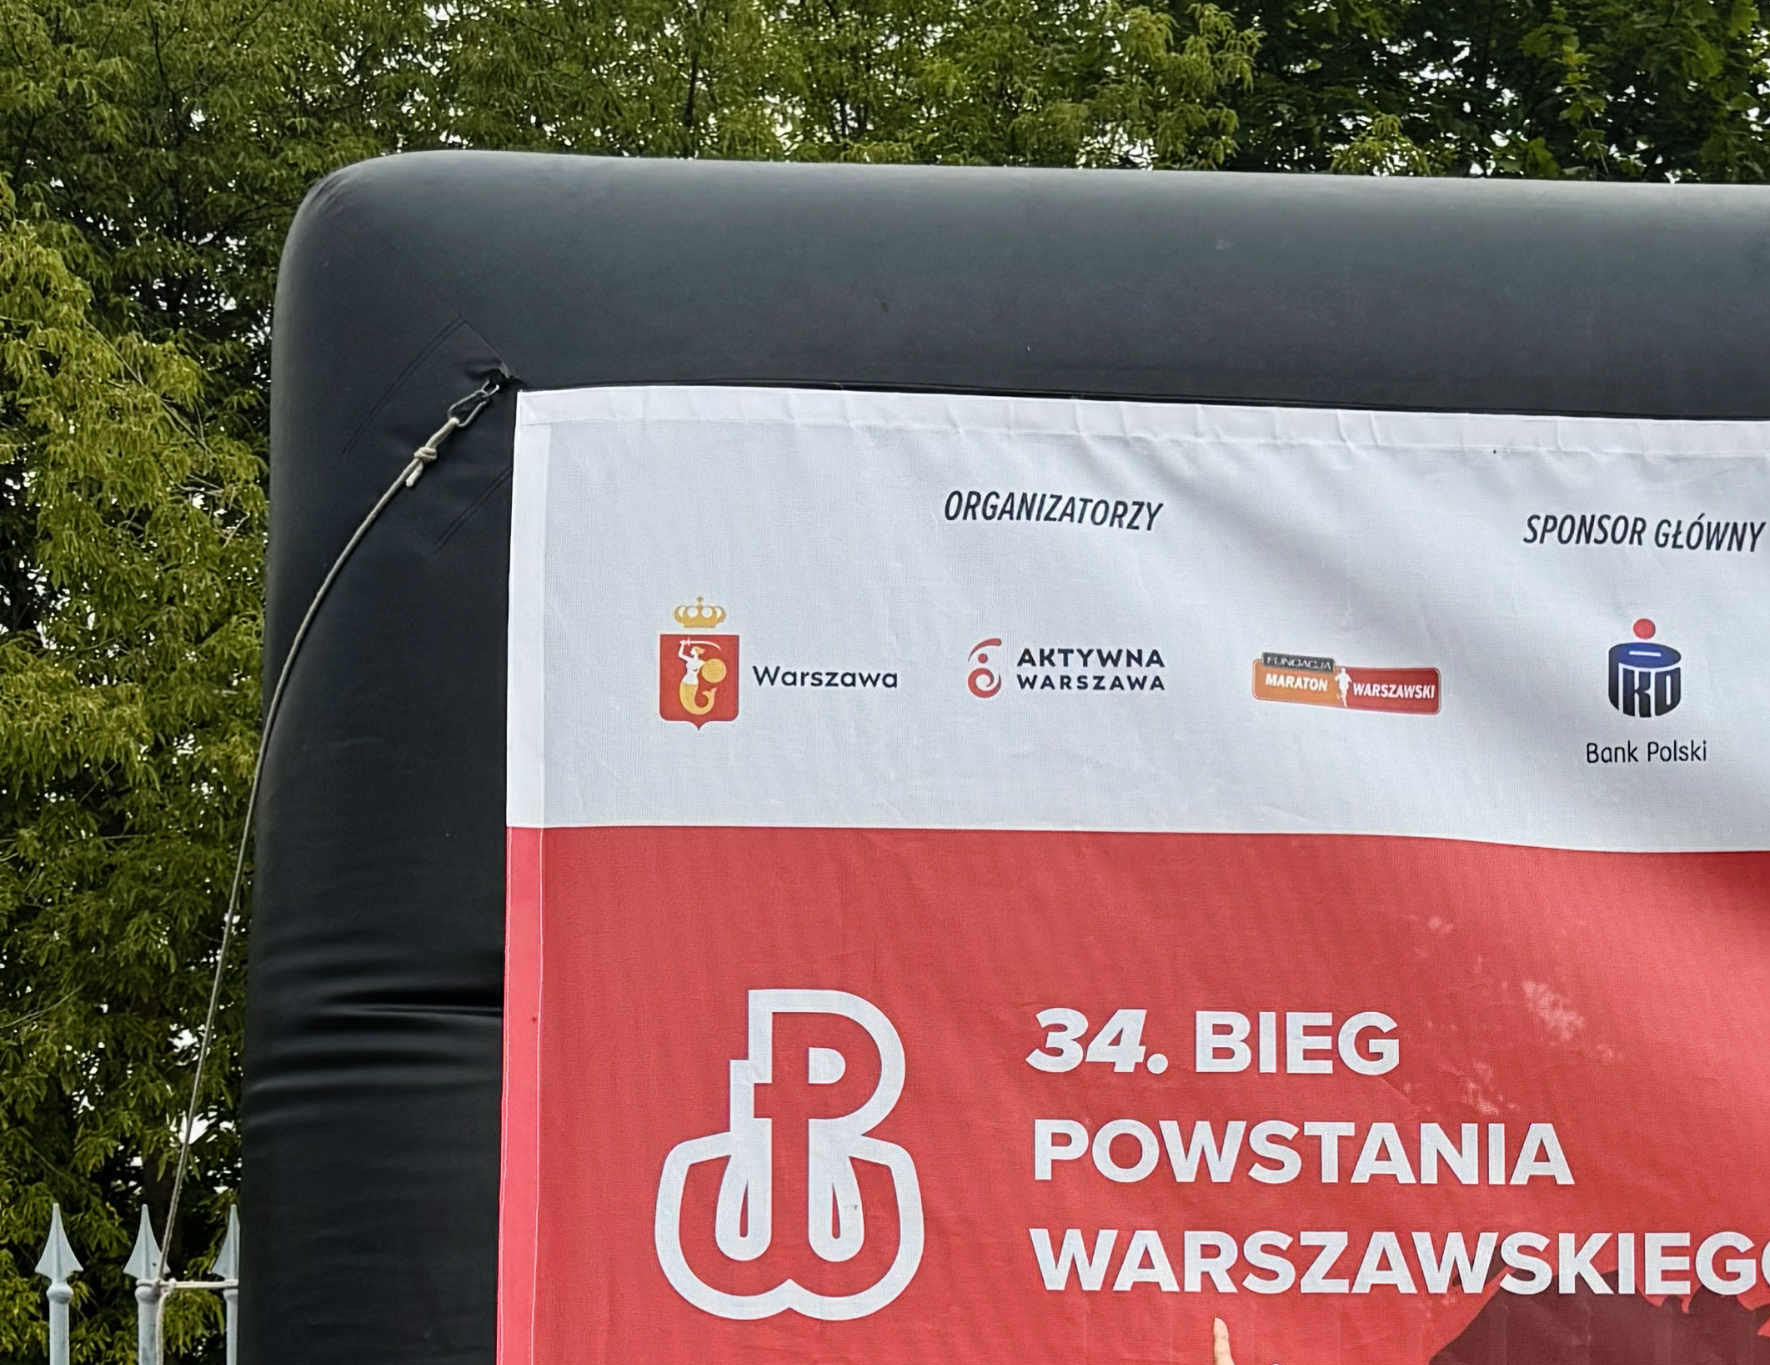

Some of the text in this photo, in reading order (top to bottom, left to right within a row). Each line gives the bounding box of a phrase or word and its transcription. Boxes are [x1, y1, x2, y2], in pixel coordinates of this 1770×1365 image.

[944, 490, 1163, 531] ORGANIZATORZY
[1523, 513, 1766, 552] SPONSOR GŁÓWNY
[1017, 648, 1165, 668] AKTYWNA
[752, 665, 898, 688] Warszawa
[1017, 674, 1165, 691] WARSZAWA
[1265, 674, 1435, 699] MARATON WARSZAWSKI
[1586, 740, 1707, 763] Bank Polski
[1025, 1008, 1400, 1075] 34. BIEG
[1034, 1119, 1575, 1185] POWSTANIA
